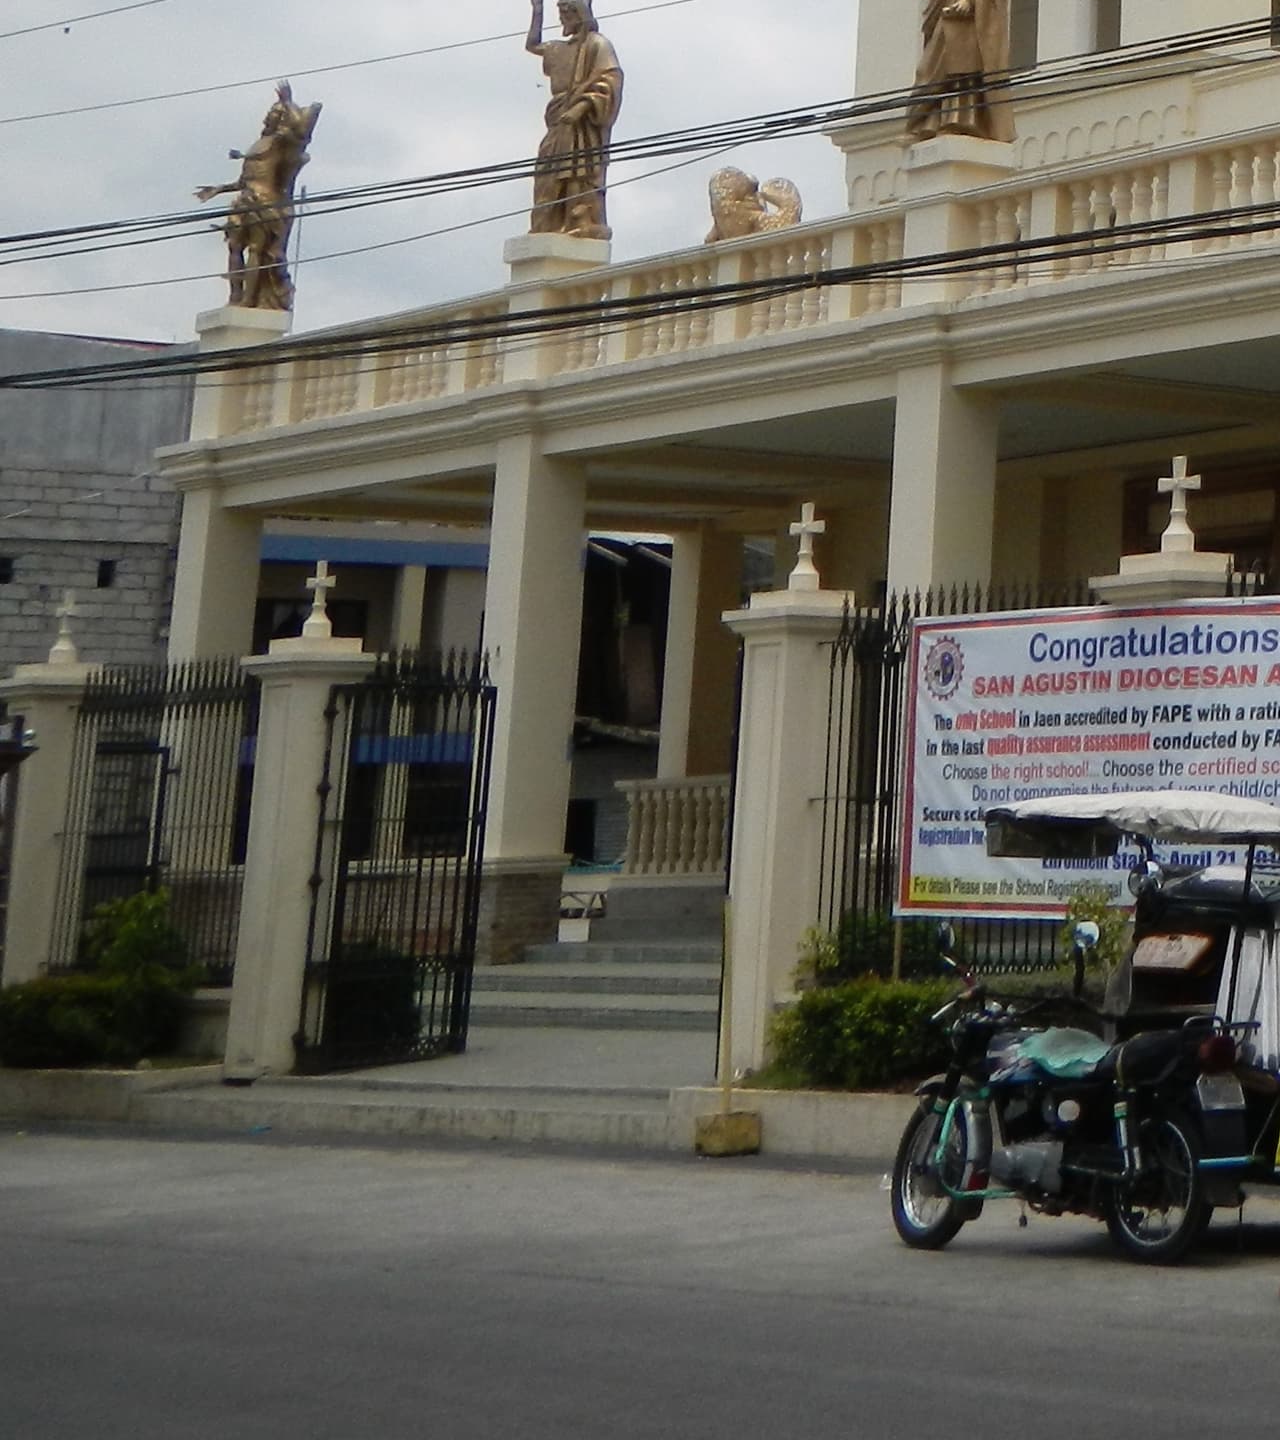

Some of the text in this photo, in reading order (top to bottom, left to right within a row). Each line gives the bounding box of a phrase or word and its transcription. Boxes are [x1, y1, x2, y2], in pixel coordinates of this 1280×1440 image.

[972, 674, 1015, 698] SAN
[1021, 669, 1112, 696] AGUSTIN
[1118, 664, 1258, 691] DIOCESAN
[934, 713, 953, 731] The
[956, 711, 978, 732] only
[979, 708, 1016, 729] School
[1018, 708, 1030, 727] in
[1033, 708, 1062, 728] Jaen
[1064, 706, 1127, 727] accredited
[1131, 706, 1149, 728] by
[1151, 704, 1193, 724] FAPE
[1197, 702, 1231, 722] with
[1234, 706, 1246, 721] a
[926, 737, 938, 756] in
[941, 737, 959, 755] the
[961, 736, 985, 755] last
[987, 734, 1024, 757] quality
[1026, 736, 1082, 754] assurance
[1083, 731, 1151, 753] assessment
[1152, 730, 1237, 752] conducted
[1240, 729, 1260, 752] by
[942, 763, 988, 781] Choose
[991, 762, 1010, 780] the
[1013, 760, 1043, 783] right
[1102, 758, 1155, 777] Choose
[1159, 758, 1184, 776] the
[1187, 755, 1257, 777] certified
[971, 785, 988, 802] Do
[990, 784, 1010, 801] not
[922, 806, 961, 822] Secure
[952, 878, 980, 895] Please
[982, 881, 997, 896] see
[1000, 879, 1014, 895] the
[1016, 878, 1046, 897] School
